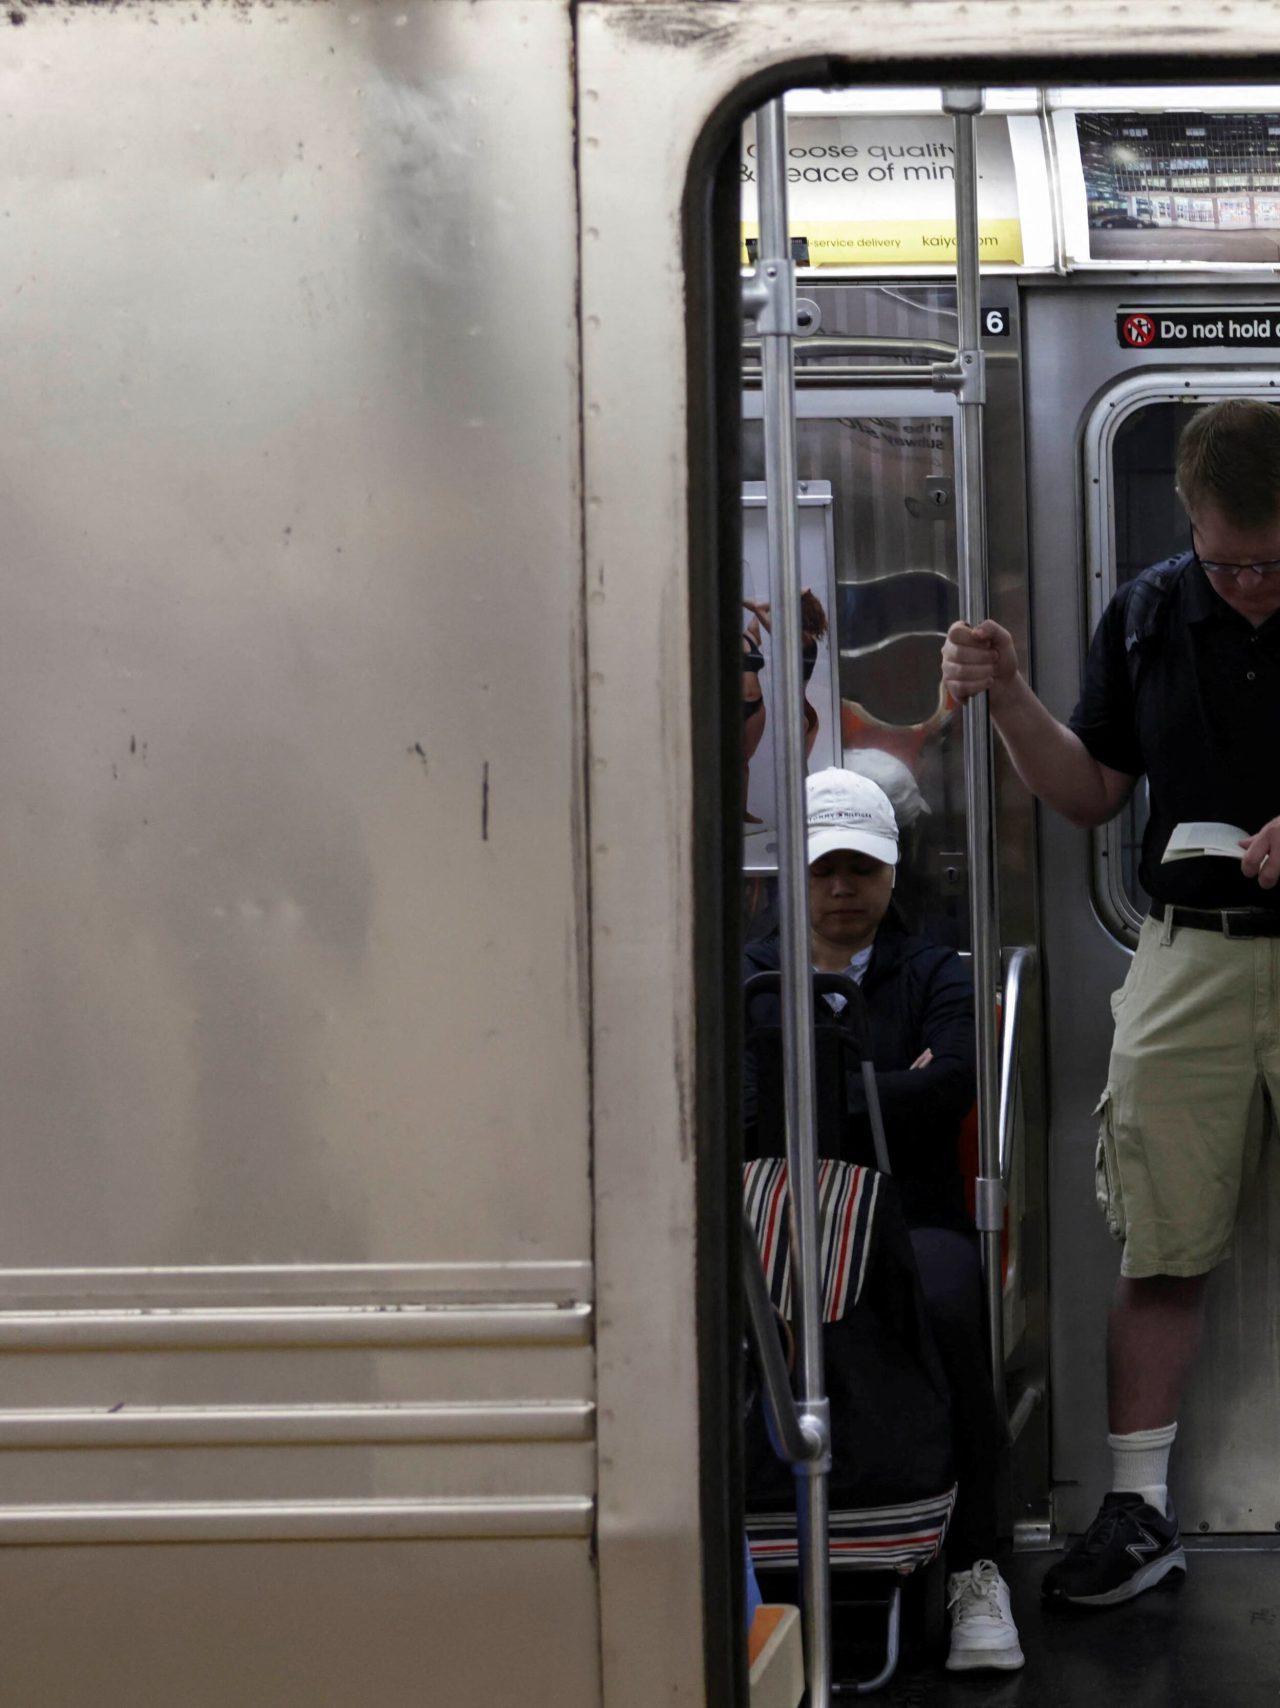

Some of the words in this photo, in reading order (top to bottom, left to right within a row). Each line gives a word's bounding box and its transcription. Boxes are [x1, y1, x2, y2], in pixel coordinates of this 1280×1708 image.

[747, 144, 858, 159] Coose
[788, 166, 859, 182] eace
[868, 162, 894, 182] of
[903, 161, 984, 181] min.
[857, 237, 901, 248] delivery
[986, 311, 1004, 334] 6
[1160, 320, 1188, 339] Do
[1193, 321, 1224, 339] not
[1229, 319, 1271, 338] hold
